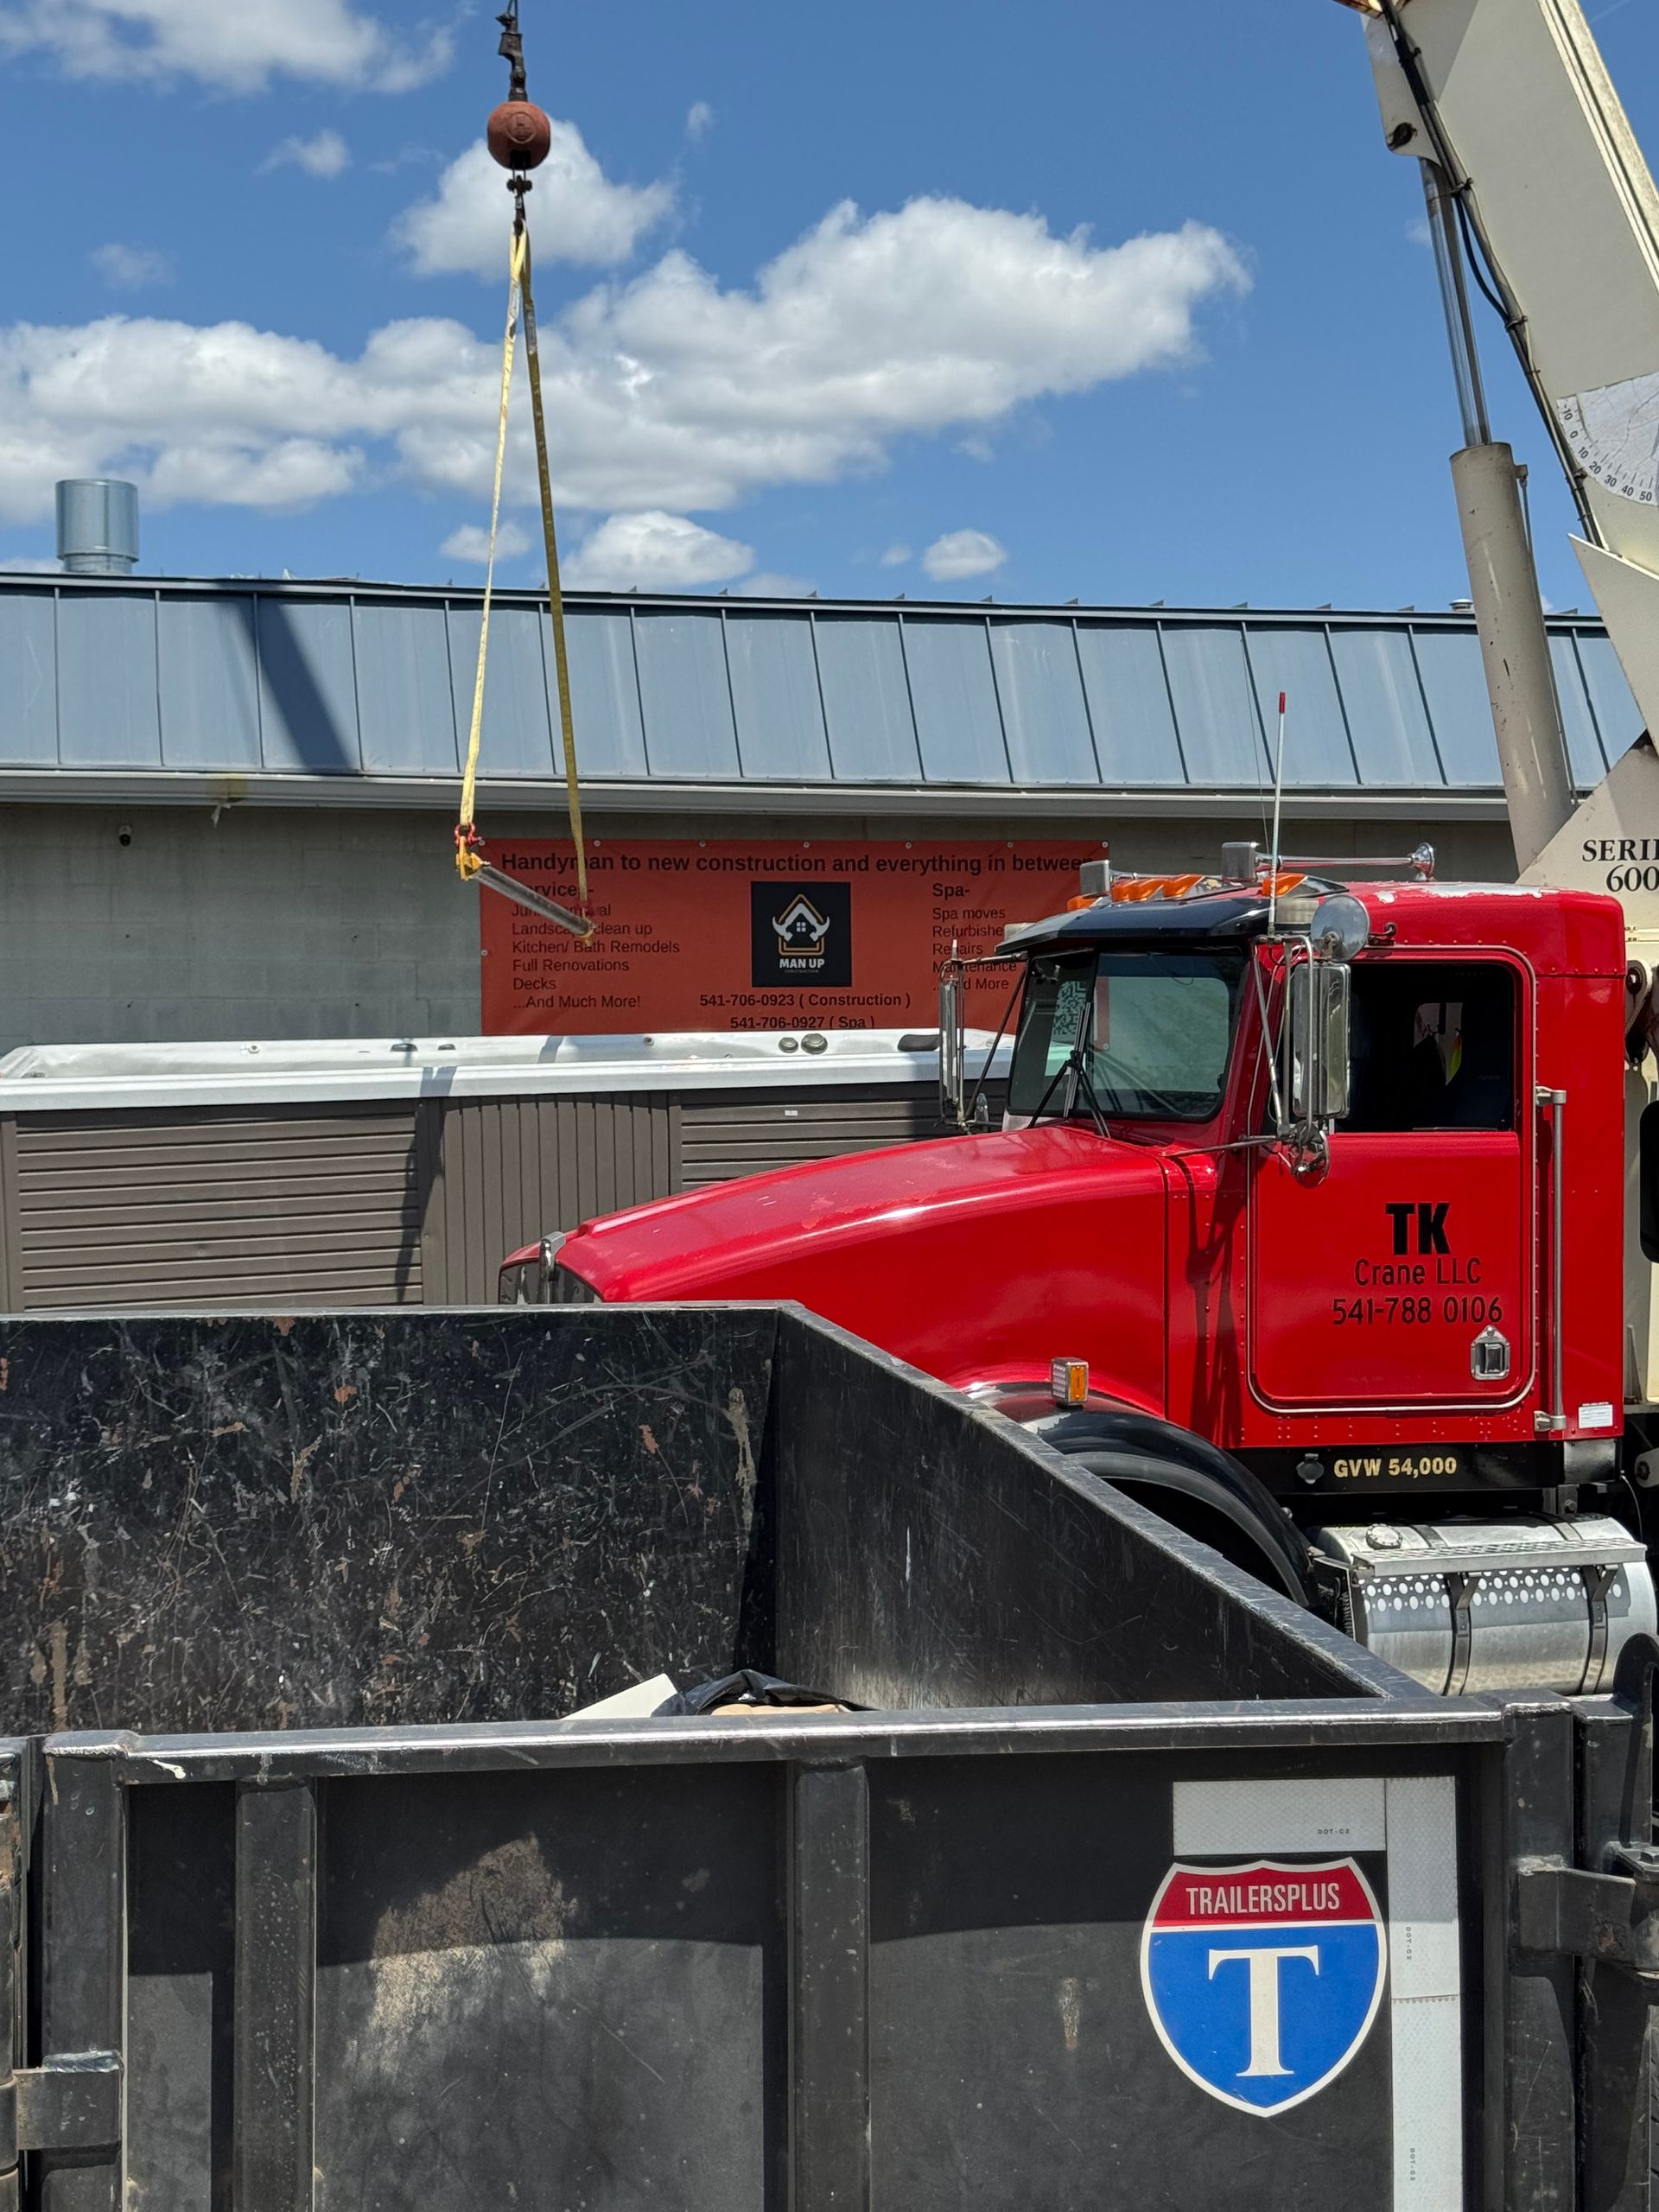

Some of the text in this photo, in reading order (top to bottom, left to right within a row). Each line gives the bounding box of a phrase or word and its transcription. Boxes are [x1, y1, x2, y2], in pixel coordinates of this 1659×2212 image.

[1578, 447, 1589, 459] 10
[1588, 461, 1602, 474] 20
[1604, 474, 1617, 487] 30
[1621, 484, 1634, 496] 40
[1639, 491, 1652, 501] 50
[620, 855, 640, 870] to
[648, 856, 690, 870] new
[696, 854, 825, 871] construction
[832, 855, 869, 872] and
[875, 855, 982, 876] everything
[988, 854, 1006, 871] in
[932, 883, 969, 900] Spa-
[932, 907, 1006, 922] Spa moves
[512, 922, 577, 937] Landsca
[635, 924, 652, 938] up
[932, 924, 1005, 938] Refurbishe
[512, 941, 680, 954] Kitchen/ Bath Remodels
[932, 944, 983, 956] Reairs
[512, 958, 630, 971] Full Renovations
[779, 958, 825, 969] MAN UP
[513, 977, 556, 990] Decks
[976, 978, 1009, 990] More
[559, 995, 596, 1008] Much
[601, 995, 640, 1008] More!
[699, 994, 795, 1007] 541-706-0923
[808, 993, 901, 1007] Construction
[730, 1016, 824, 1029] 541-706-0927
[1385, 1202, 1452, 1255] TK
[1355, 1257, 1482, 1286] Crane LLC
[1332, 1296, 1503, 1325] 541-788 0106
[1334, 1457, 1458, 1478] GVW 54,000
[1186, 1882, 1340, 1916] TRAILERSPLUS
[1209, 1945, 1319, 2077] T
